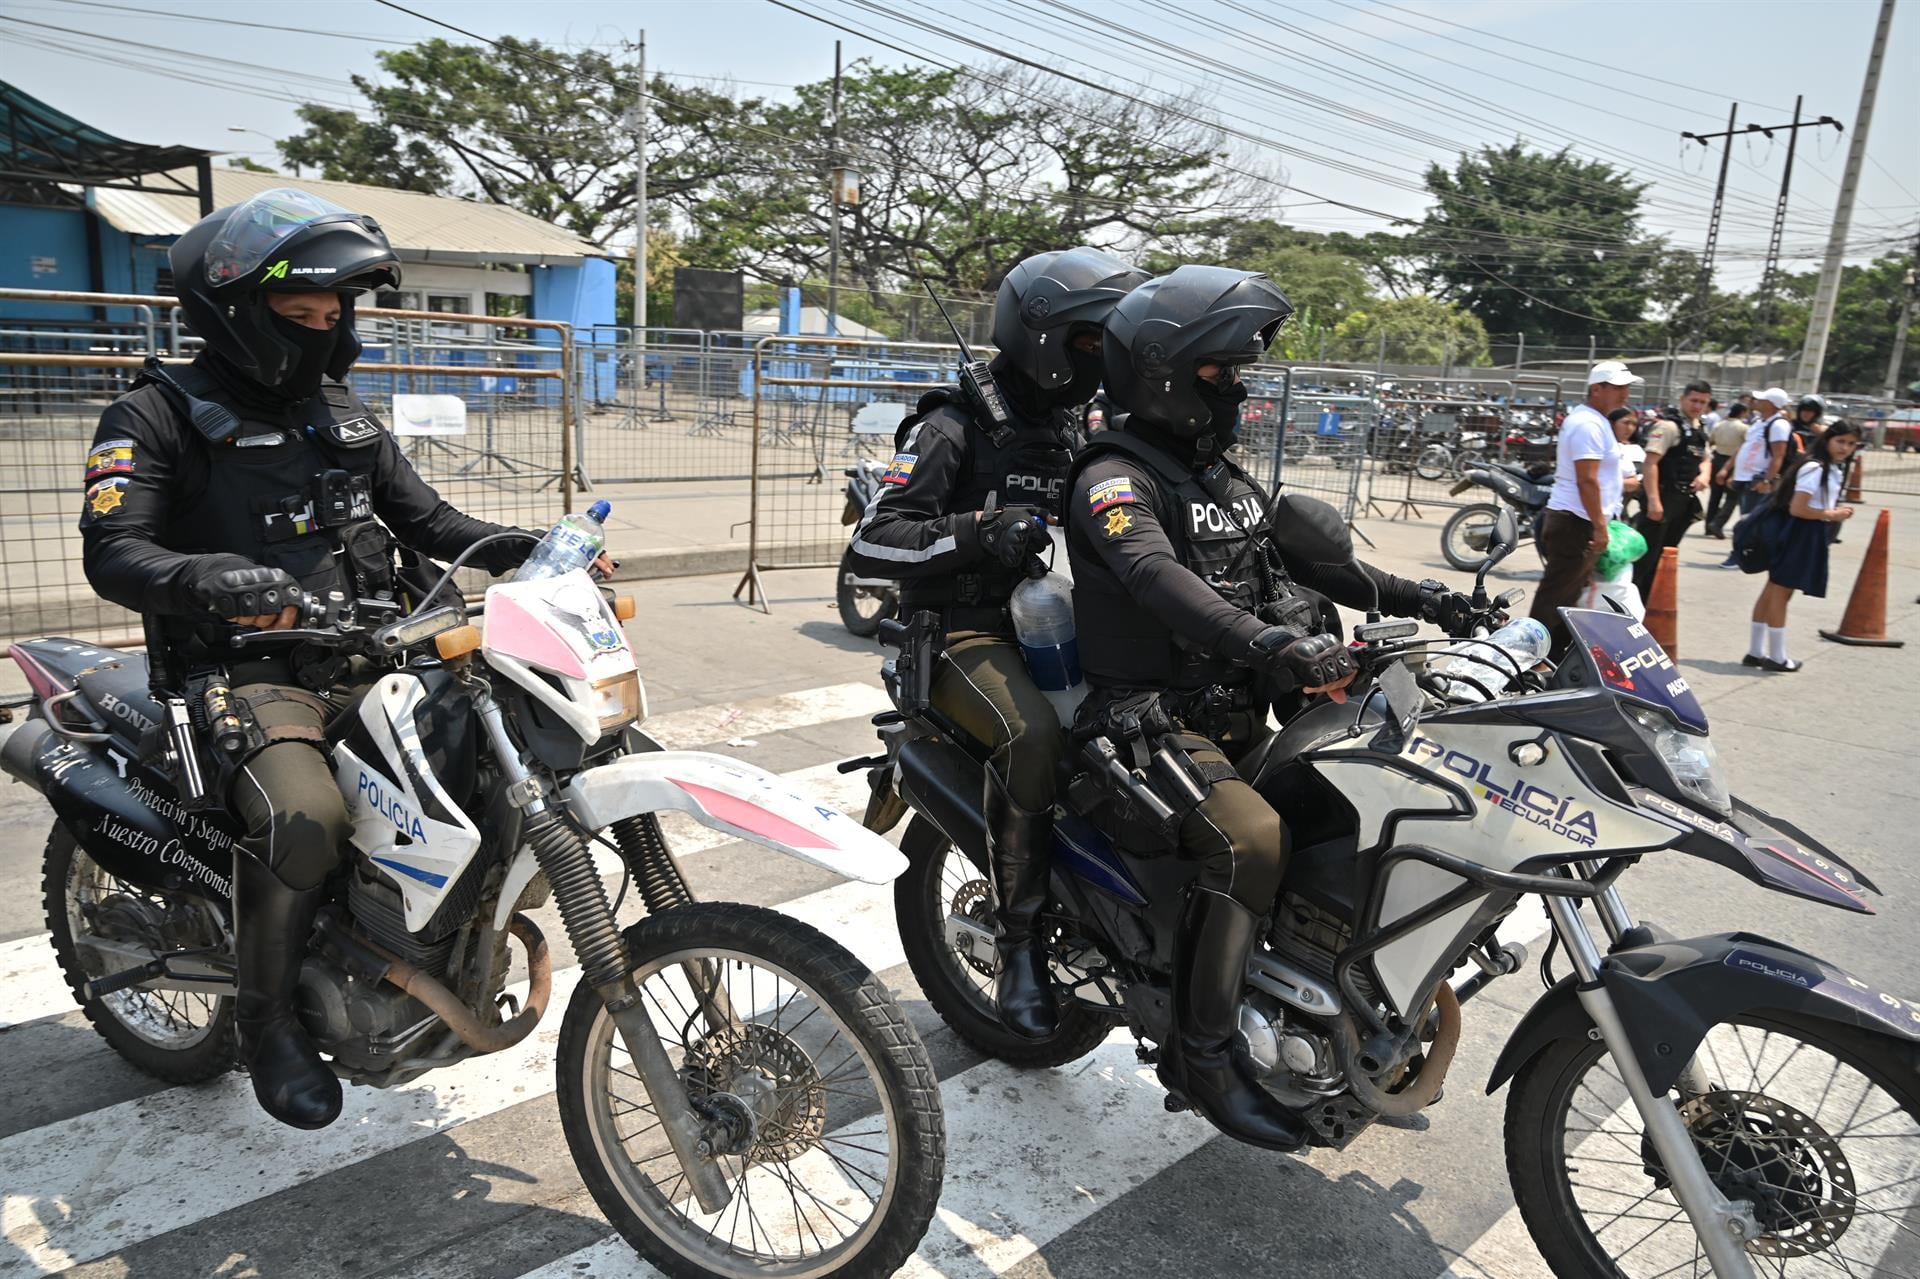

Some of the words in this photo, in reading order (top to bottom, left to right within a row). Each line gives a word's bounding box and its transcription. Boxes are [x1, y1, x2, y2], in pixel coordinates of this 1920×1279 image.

[1090, 477, 1129, 496] ECUADOR
[551, 525, 597, 561] CIELO
[358, 771, 428, 844] POLICIA
[1408, 736, 1598, 838] POLICÍA
[1499, 797, 1596, 848] ECUADOR
